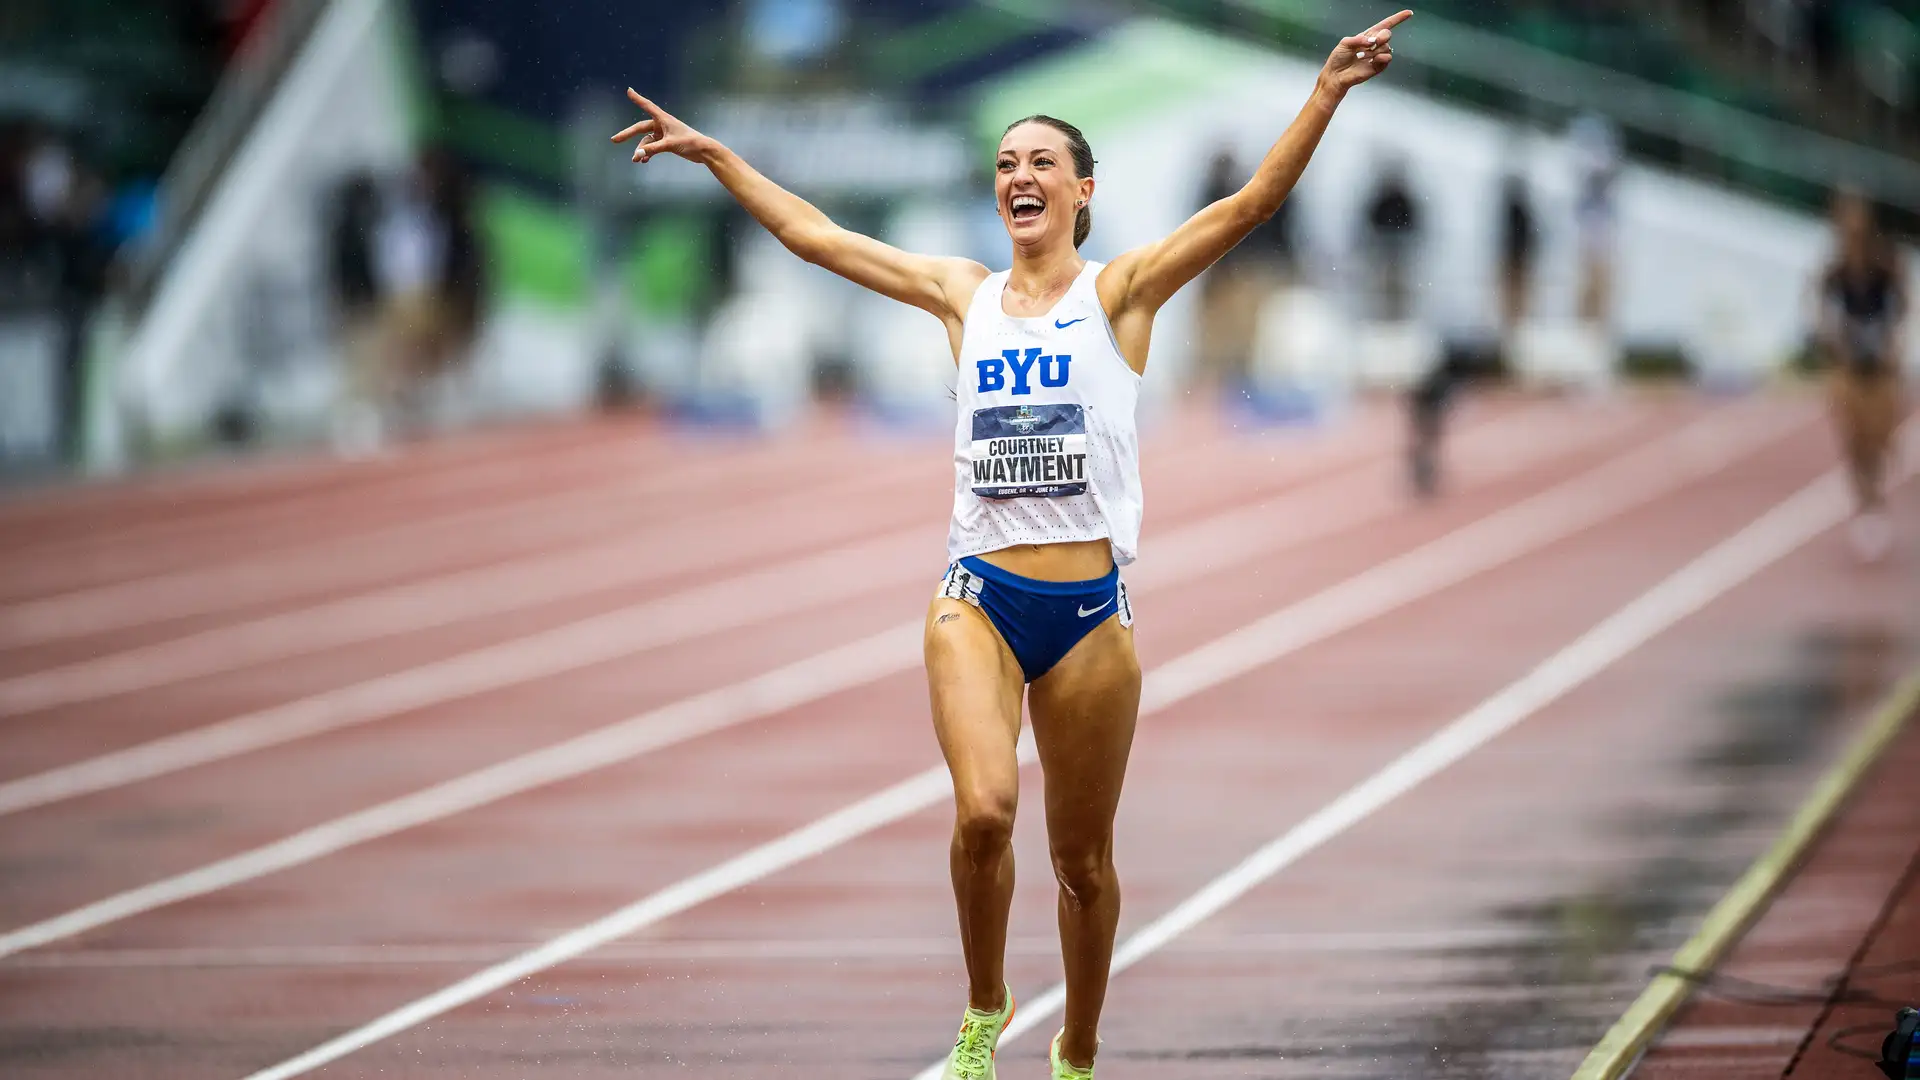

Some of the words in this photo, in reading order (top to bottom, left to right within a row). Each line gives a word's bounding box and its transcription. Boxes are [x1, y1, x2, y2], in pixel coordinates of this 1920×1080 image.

[976, 347, 1072, 396] BYU
[988, 437, 1065, 457] COURTNEY
[972, 453, 1087, 484] WAYMENT
